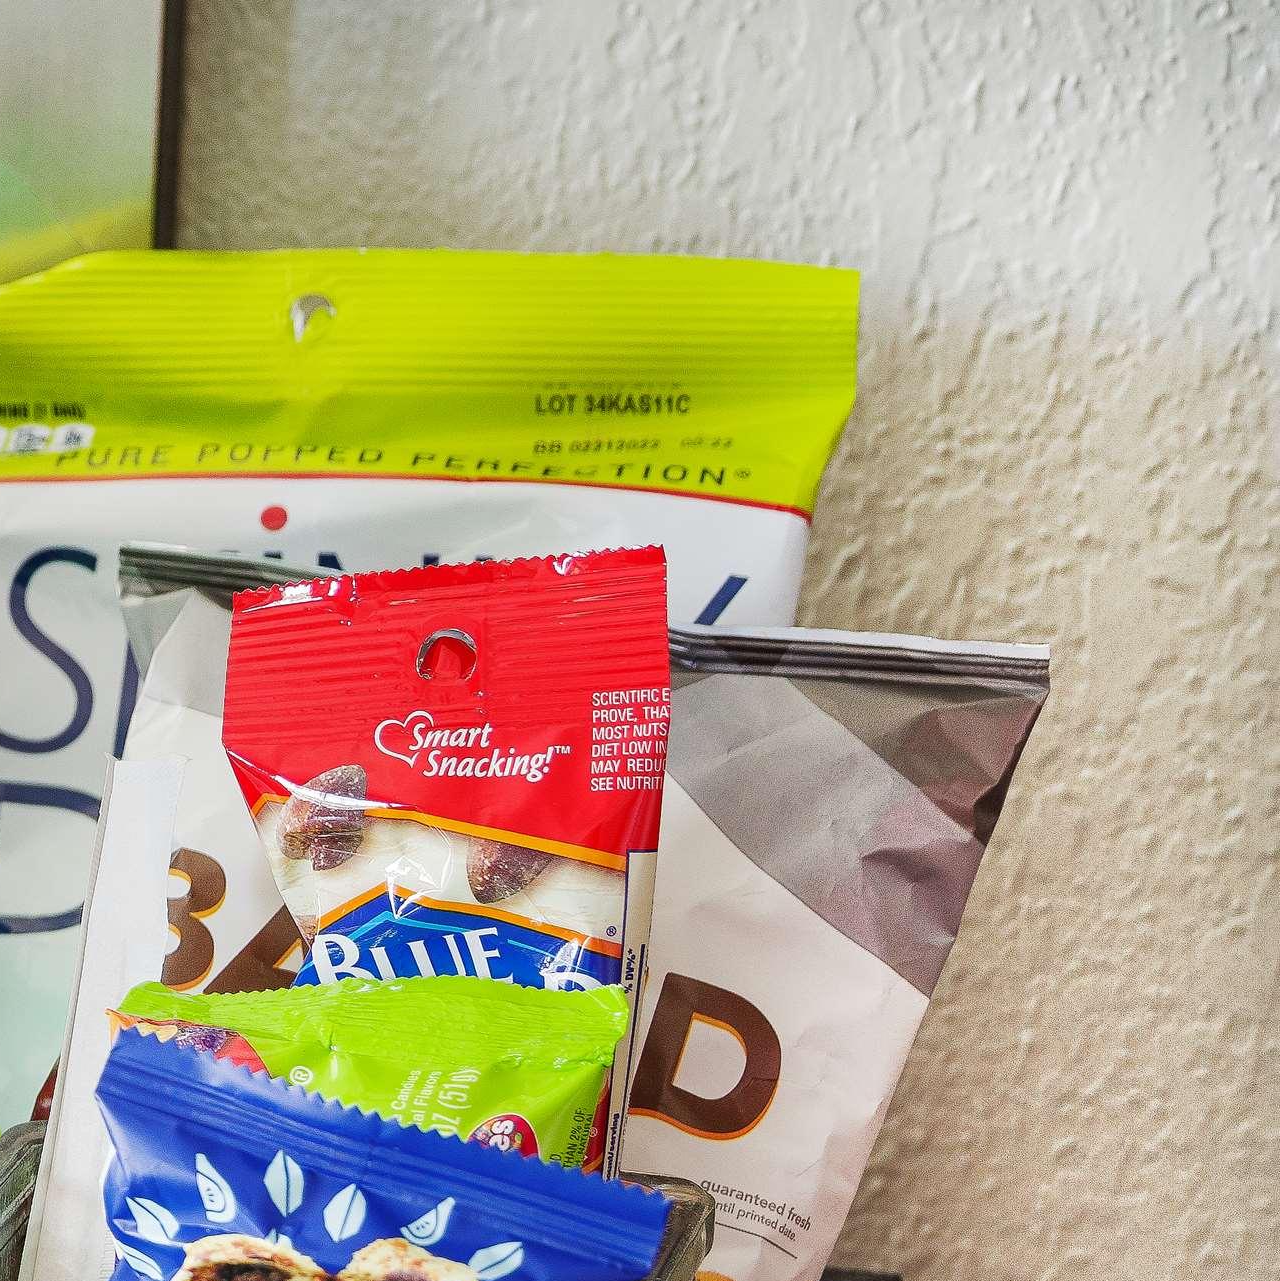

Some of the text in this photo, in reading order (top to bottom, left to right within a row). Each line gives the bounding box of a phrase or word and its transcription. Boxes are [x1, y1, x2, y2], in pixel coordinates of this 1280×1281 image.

[534, 393, 579, 416] LOT
[55, 444, 171, 471] PURE
[592, 688, 660, 707] SCIENTIFIC
[592, 707, 638, 723] PROVE,
[411, 721, 492, 751] Smart
[592, 722, 668, 741] MOST NUTS
[591, 742, 620, 758] DIET
[623, 740, 653, 756] LOW
[591, 759, 622, 775] MAY
[590, 776, 614, 792] SEE
[699, 1178, 812, 1232] guaranteed fresh
[736, 1207, 778, 1231] printed
